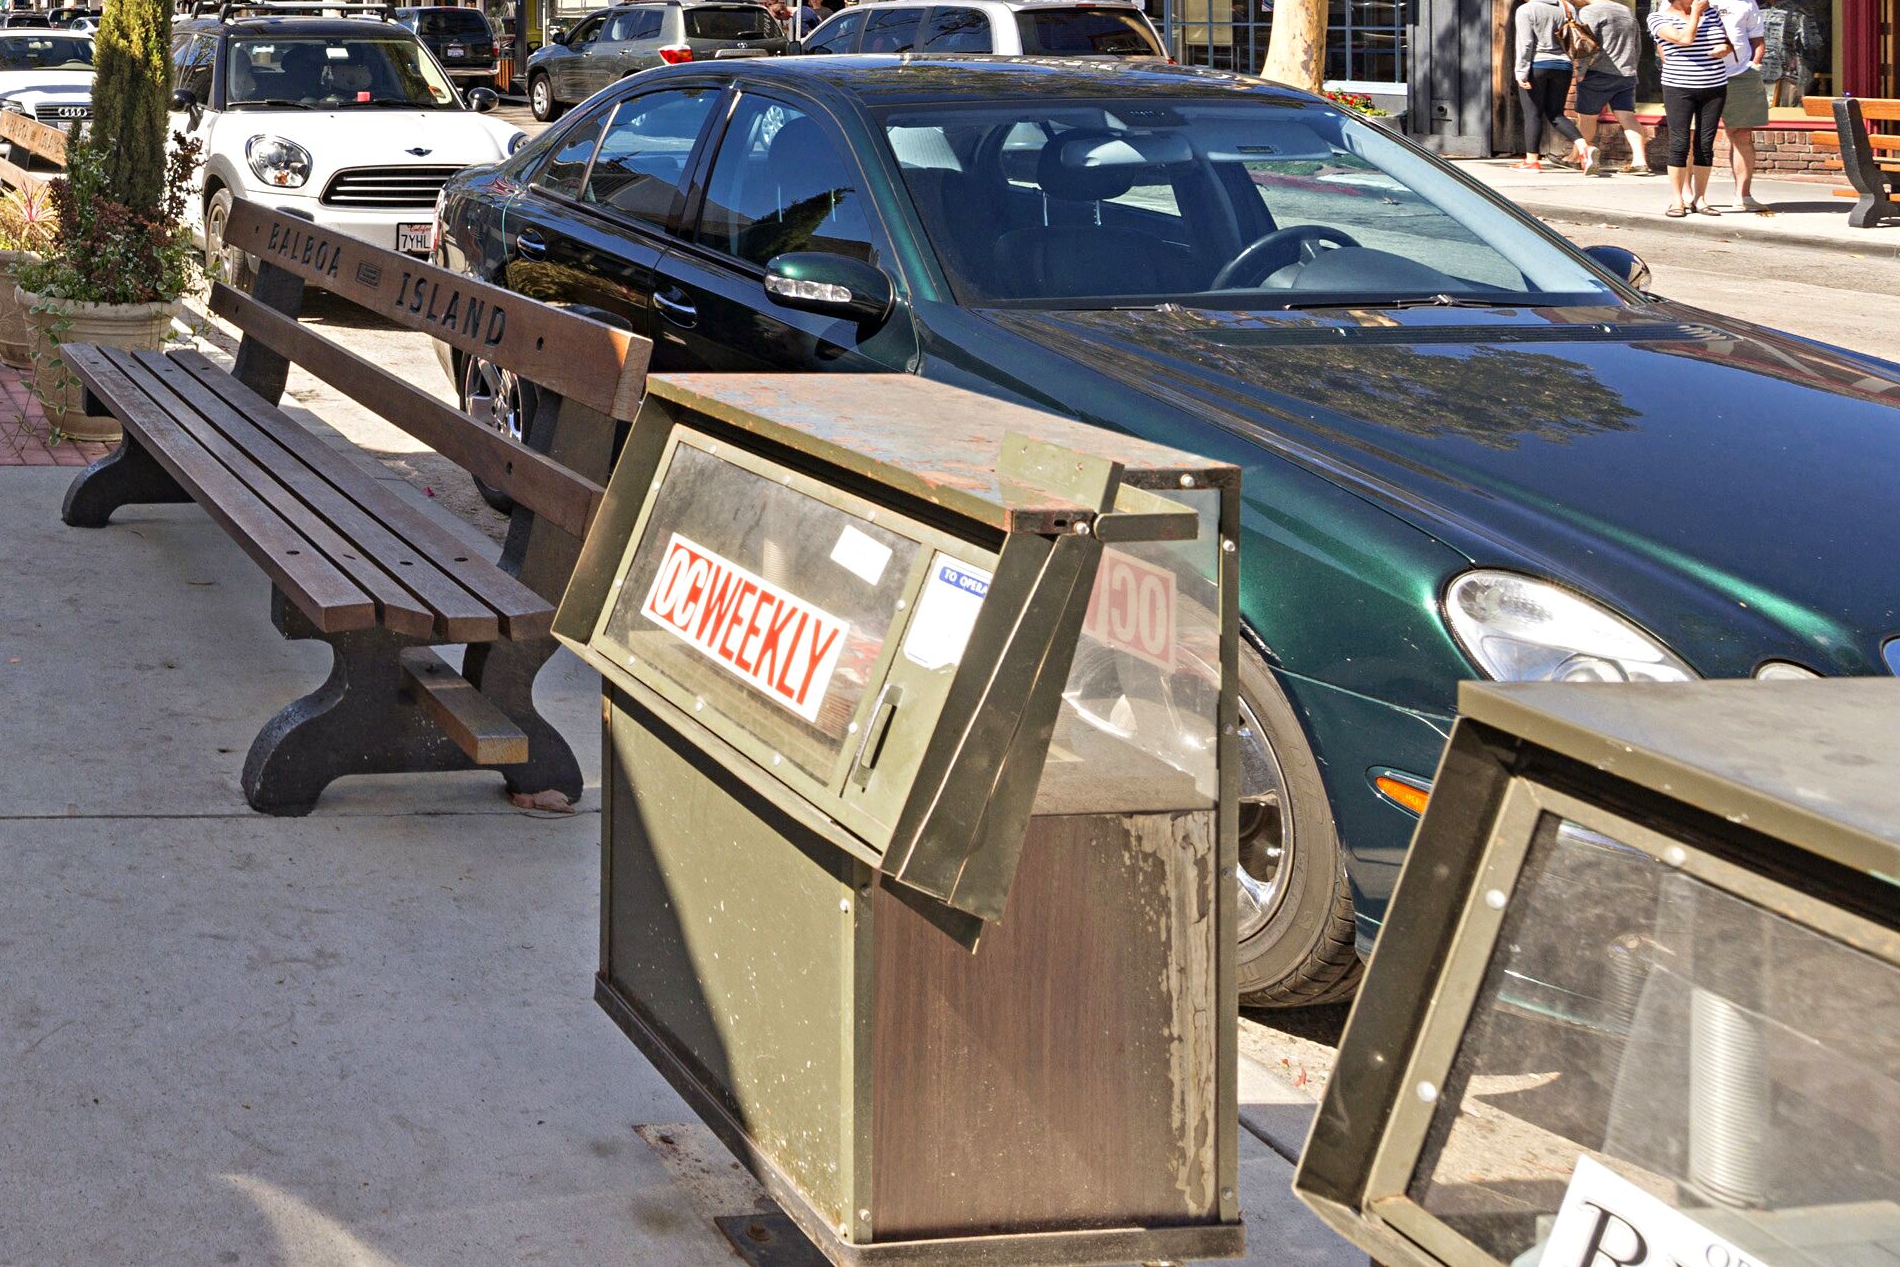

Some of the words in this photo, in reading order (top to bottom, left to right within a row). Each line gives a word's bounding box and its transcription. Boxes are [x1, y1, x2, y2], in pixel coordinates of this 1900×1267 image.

[400, 234, 431, 249] 7YHL
[267, 222, 341, 278] BALBOA
[395, 272, 507, 348] ISLAND
[944, 569, 958, 583] TO
[959, 575, 989, 594] OPERA
